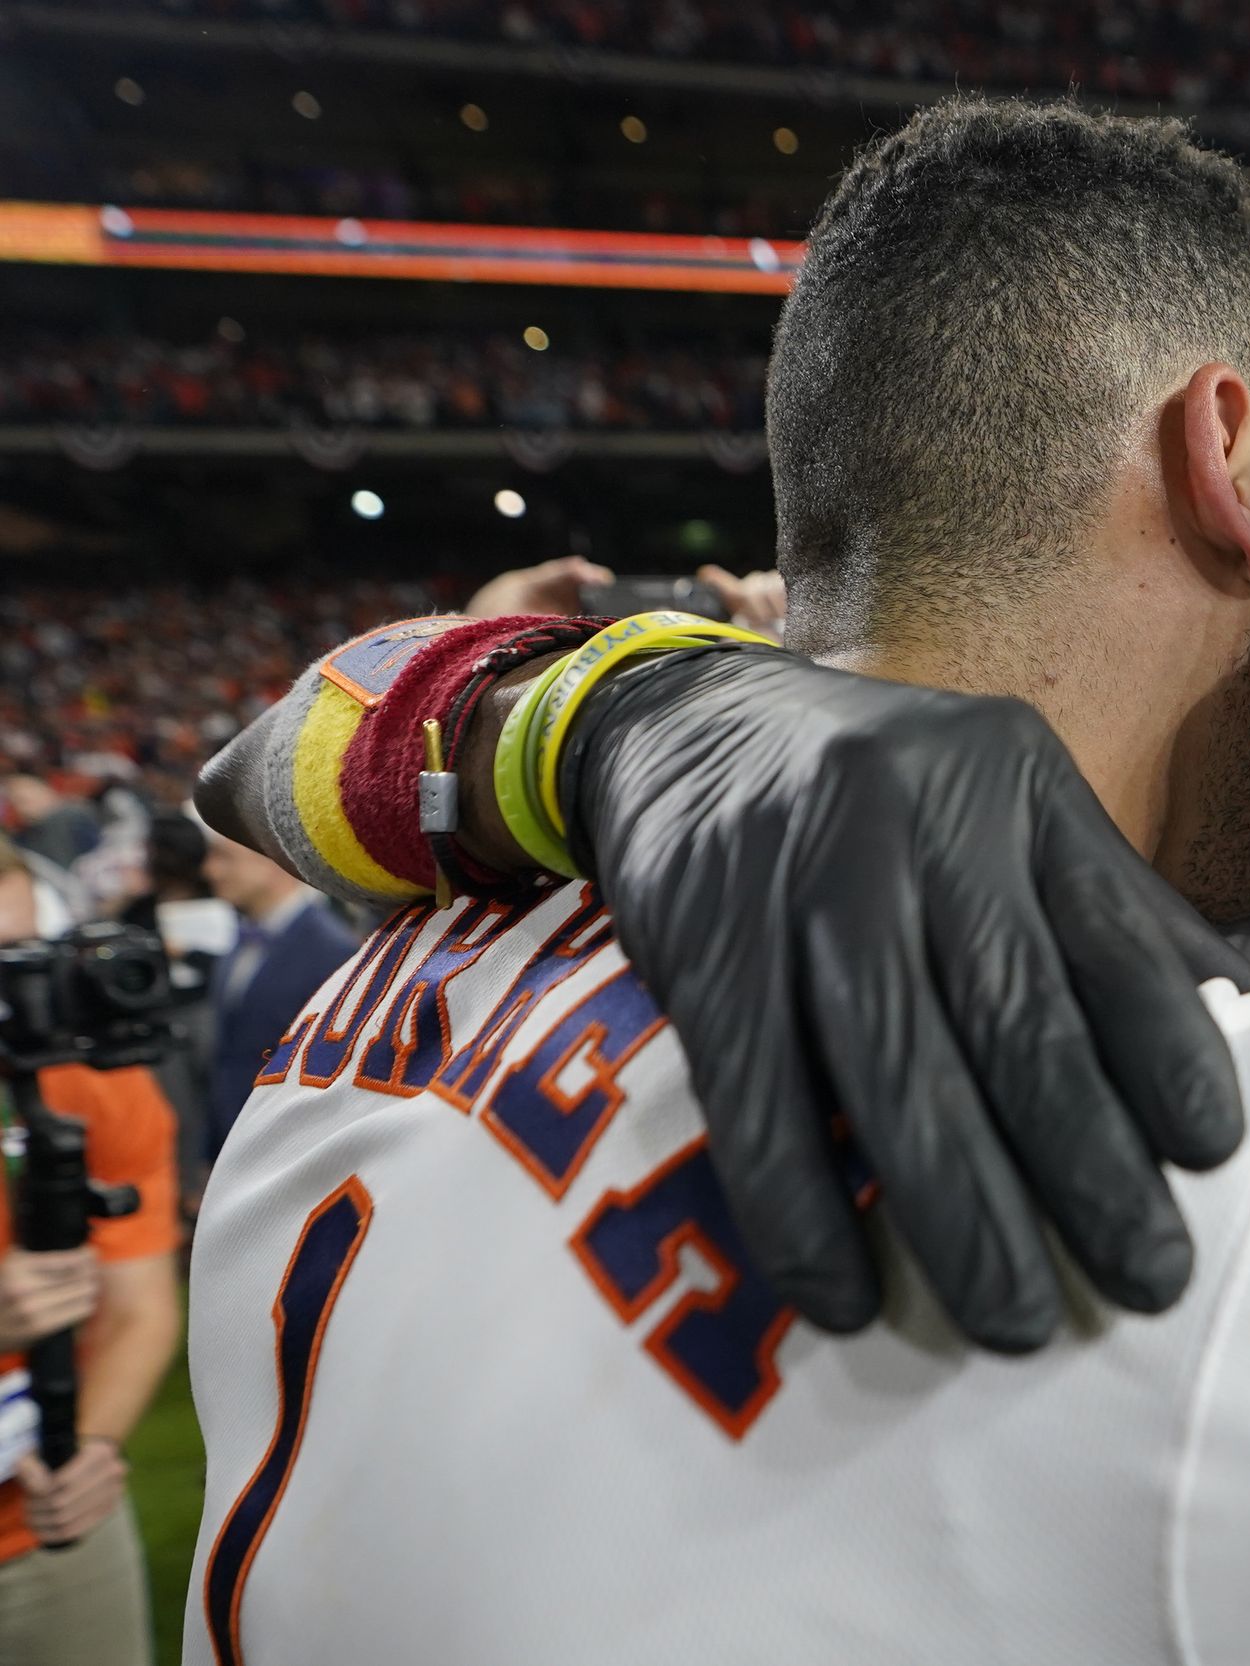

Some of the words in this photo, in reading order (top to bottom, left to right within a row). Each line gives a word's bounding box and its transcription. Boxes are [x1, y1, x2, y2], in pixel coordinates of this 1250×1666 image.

[543, 620, 647, 737] PYBURN
[254, 880, 802, 1446] ORREA
[204, 1174, 374, 1666] 1
